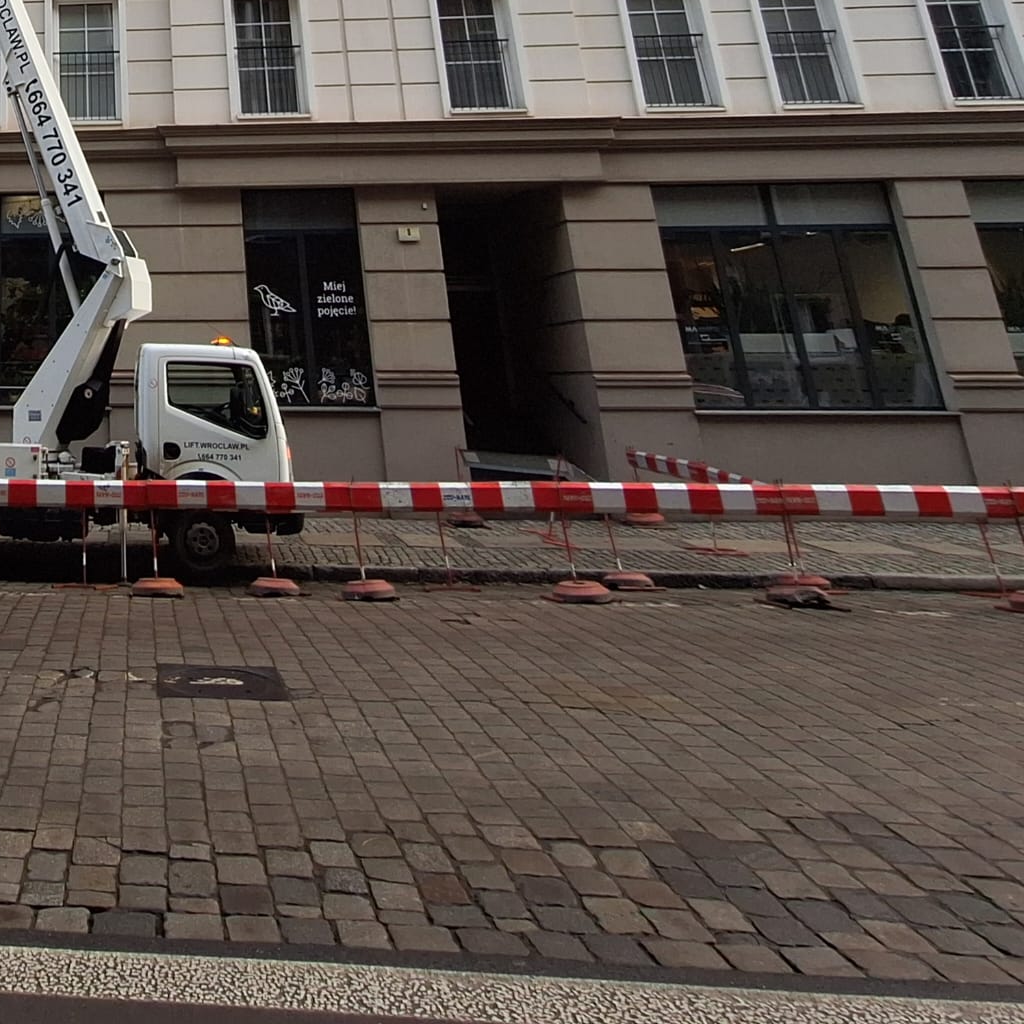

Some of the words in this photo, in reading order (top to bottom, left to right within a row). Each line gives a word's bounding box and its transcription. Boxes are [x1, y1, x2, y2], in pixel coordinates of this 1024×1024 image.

[28, 90, 52, 127] 664
[42, 127, 66, 166] 770
[57, 167, 83, 208] 341
[323, 280, 346, 293] Miej
[316, 293, 354, 303] zielone
[183, 441, 250, 451] LIFT.WROCLAW.PL
